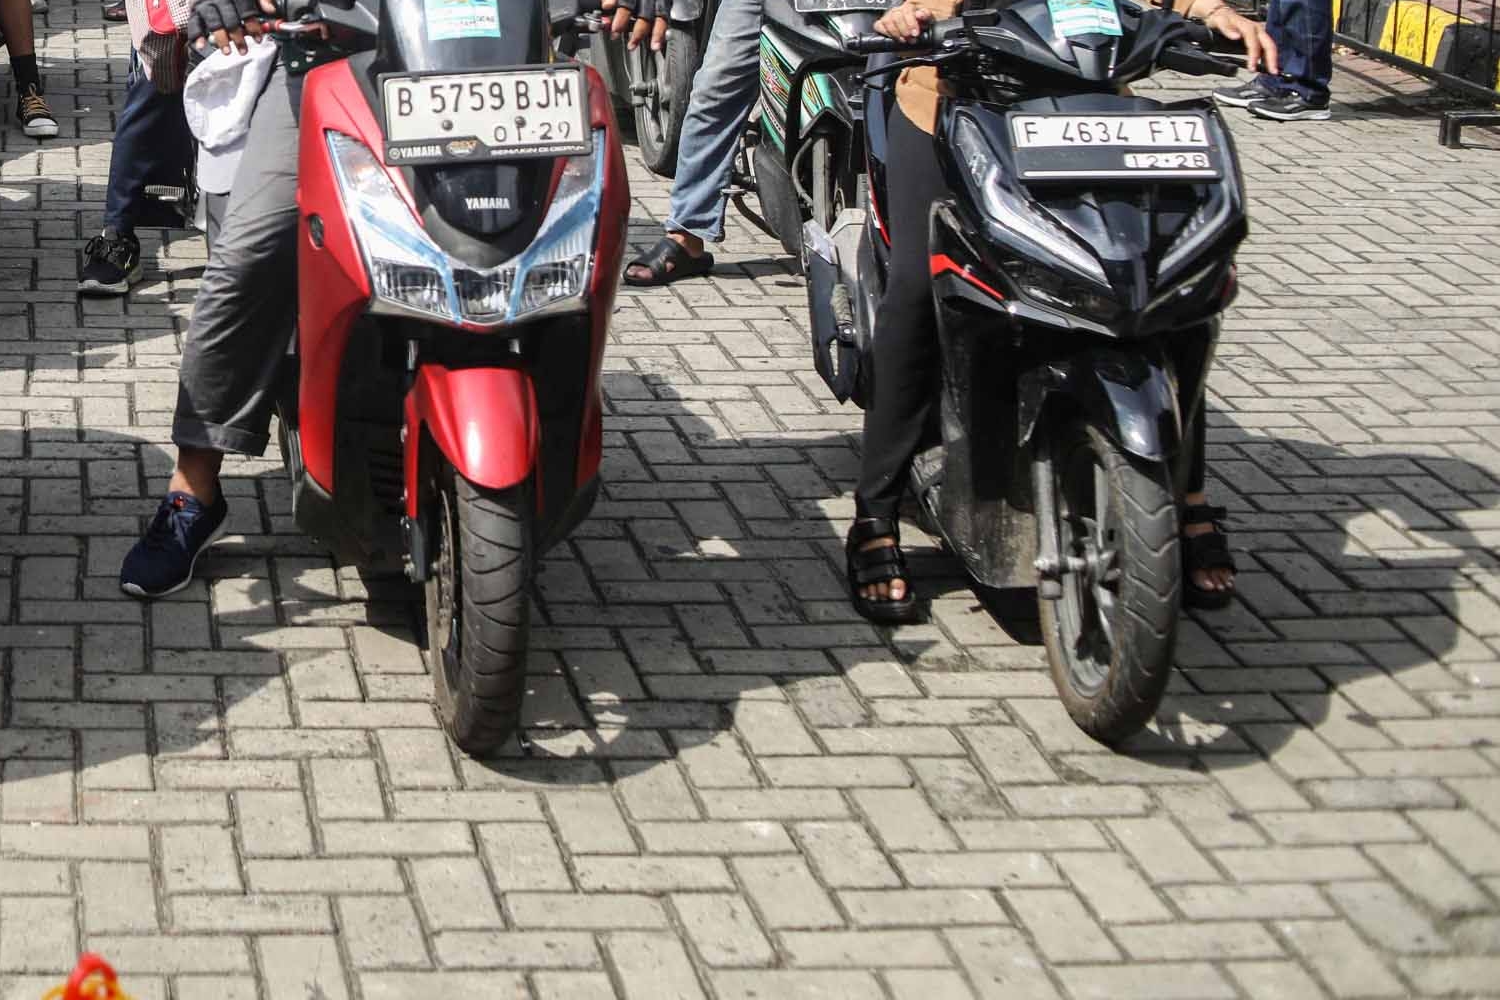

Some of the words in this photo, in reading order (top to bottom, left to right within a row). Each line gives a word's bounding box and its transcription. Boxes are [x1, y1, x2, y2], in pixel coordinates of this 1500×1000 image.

[398, 87, 413, 117] B
[430, 82, 505, 114] 5759
[515, 78, 573, 110] BJM
[1024, 121, 1038, 143] F
[1062, 121, 1129, 143] 4634
[1149, 120, 1204, 143] FIZ
[401, 145, 444, 158] YAMAHA
[464, 197, 511, 210] YAMAHA
